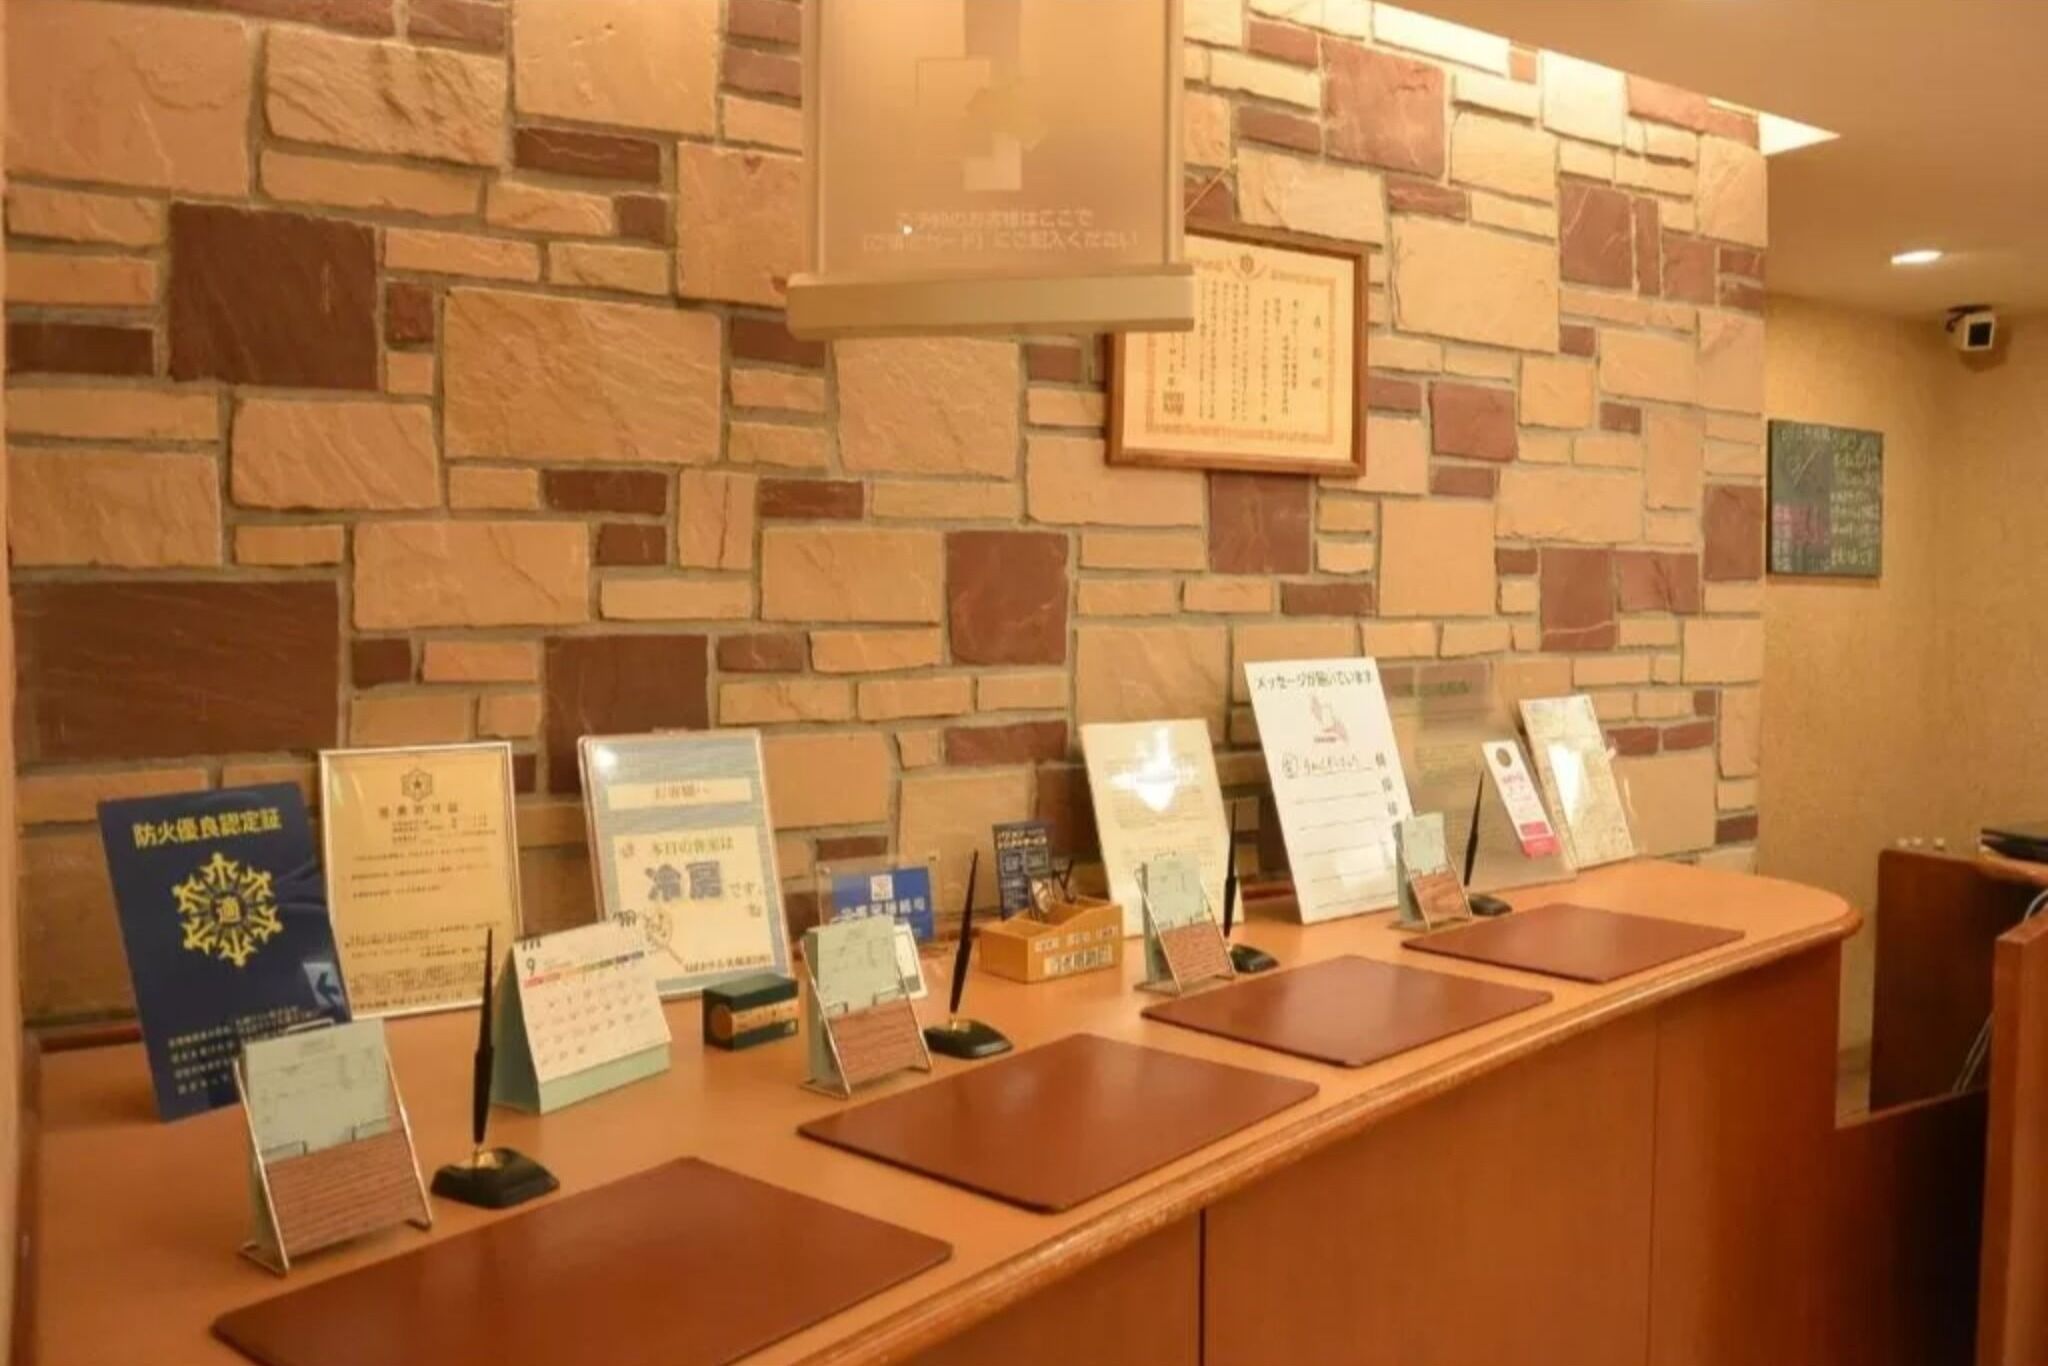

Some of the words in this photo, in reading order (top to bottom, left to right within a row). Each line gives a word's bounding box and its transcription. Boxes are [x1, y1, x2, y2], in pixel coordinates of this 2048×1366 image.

[132, 808, 284, 848] 防火優良認定証
[645, 860, 722, 902] 冷房
